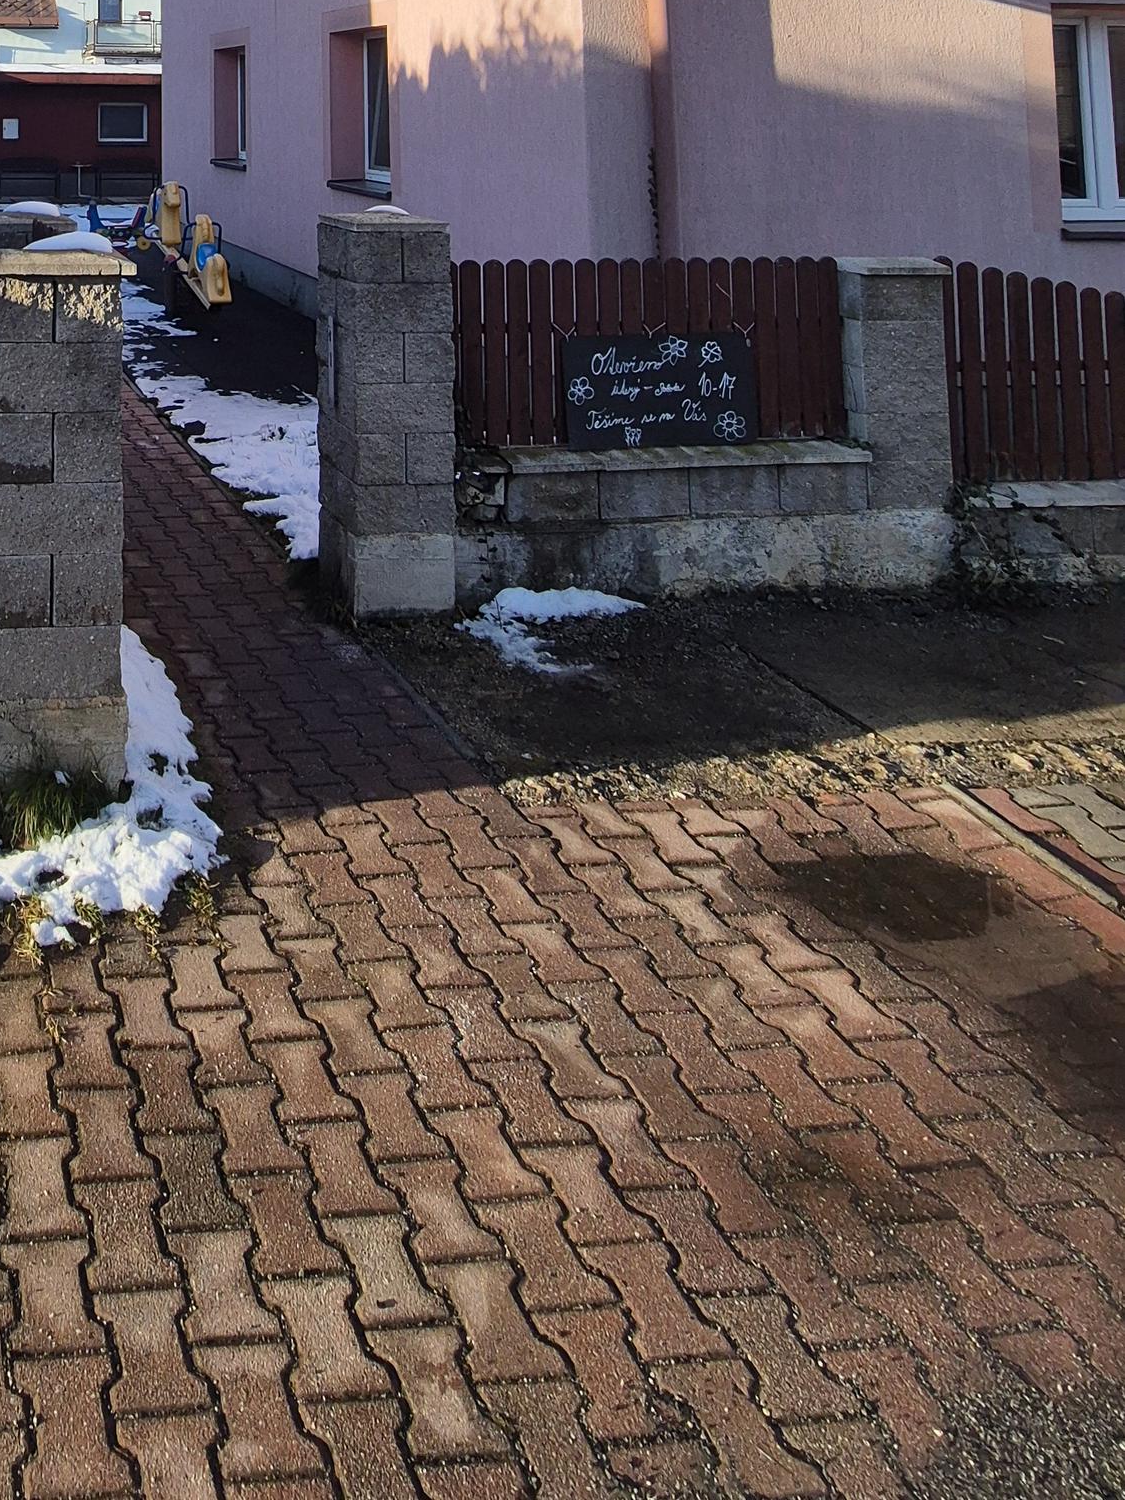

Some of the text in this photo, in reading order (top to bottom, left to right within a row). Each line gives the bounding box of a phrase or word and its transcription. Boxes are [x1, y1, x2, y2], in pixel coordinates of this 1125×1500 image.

[698, 371, 737, 400] 10-17
[641, 414, 657, 423] se
[658, 412, 676, 422] na
